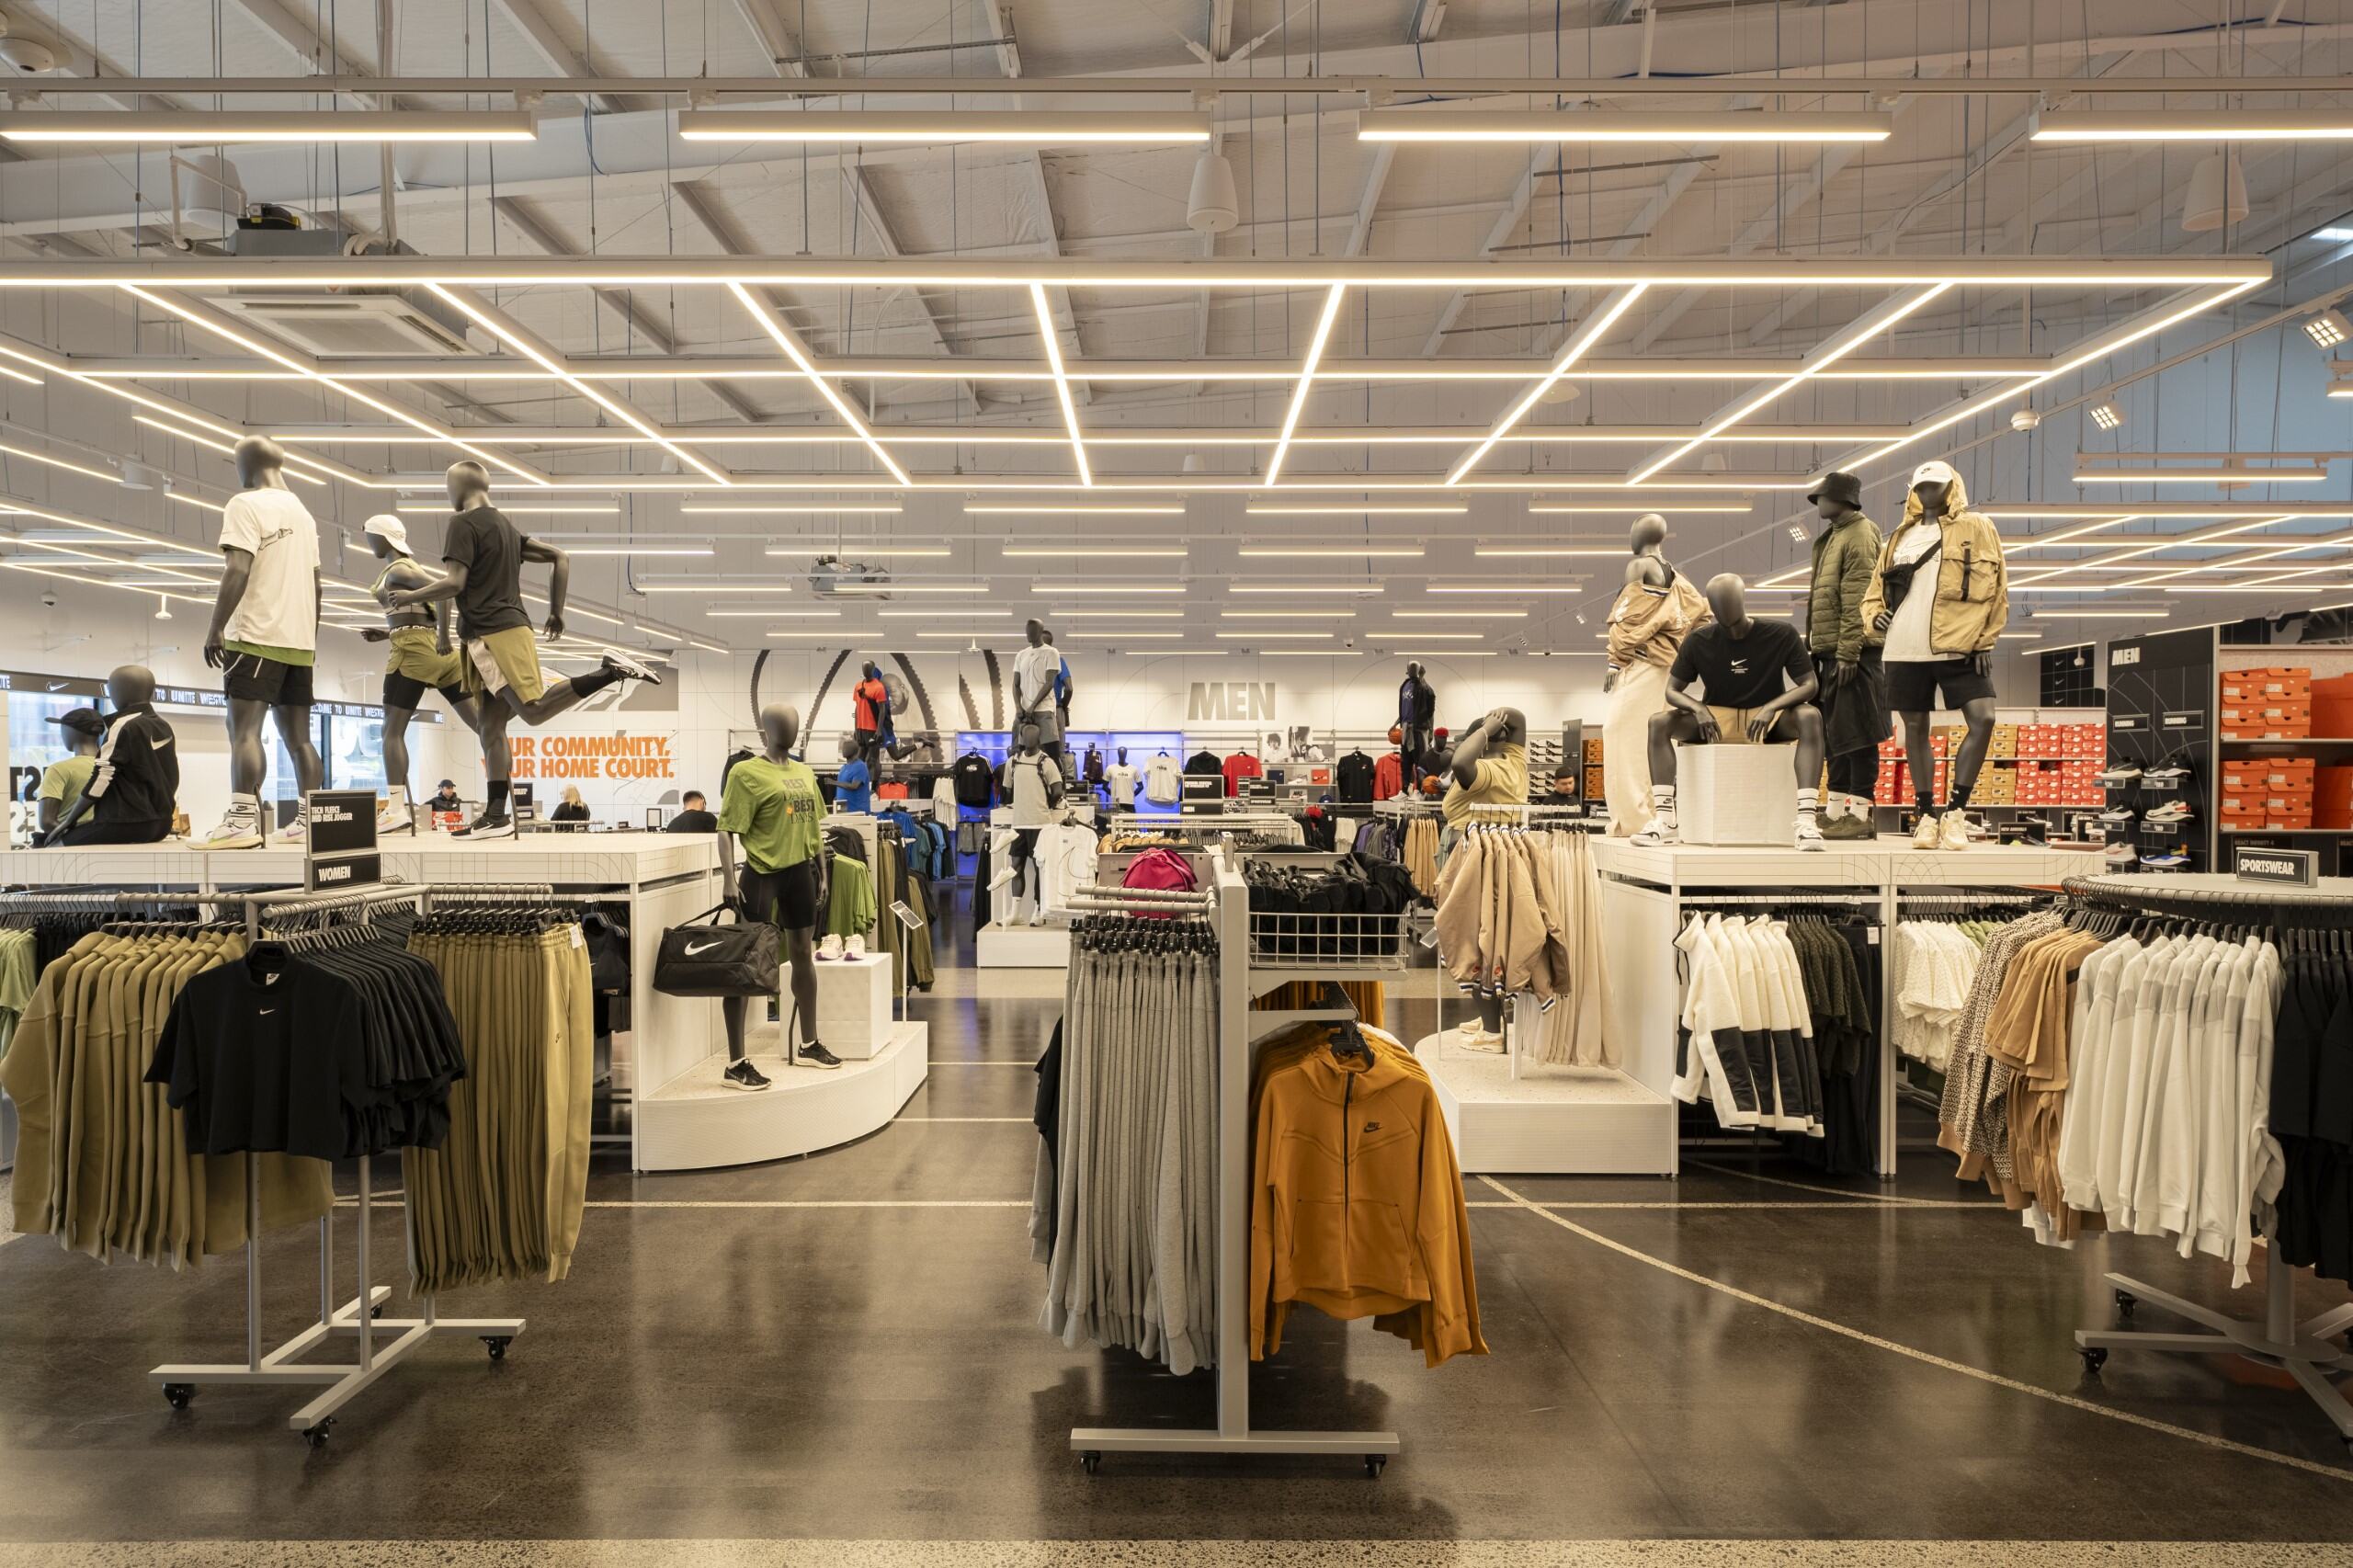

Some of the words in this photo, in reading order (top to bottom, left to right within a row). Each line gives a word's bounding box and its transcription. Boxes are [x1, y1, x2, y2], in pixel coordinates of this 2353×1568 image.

[2111, 647, 2140, 666] MEN
[171, 690, 196, 704] UNITE
[1188, 682, 1276, 721] MEN
[311, 703, 333, 714] LCOME
[346, 706, 362, 717] UNITE
[508, 736, 536, 757] UR
[540, 736, 671, 757] COMMUNITY,
[509, 757, 537, 778] UR
[541, 757, 599, 778] HOME
[605, 757, 675, 778] COURT.
[782, 778, 807, 790] REST
[312, 806, 324, 814] TECH
[324, 805, 340, 813] FLEECE
[793, 799, 815, 812] BEST
[312, 814, 322, 823] MID
[323, 813, 333, 822] RISE
[334, 812, 353, 821] JOGGER
[790, 812, 813, 824] DAYS
[318, 866, 351, 881] WOMEN
[2240, 858, 2294, 875] SPORTSWEAR
